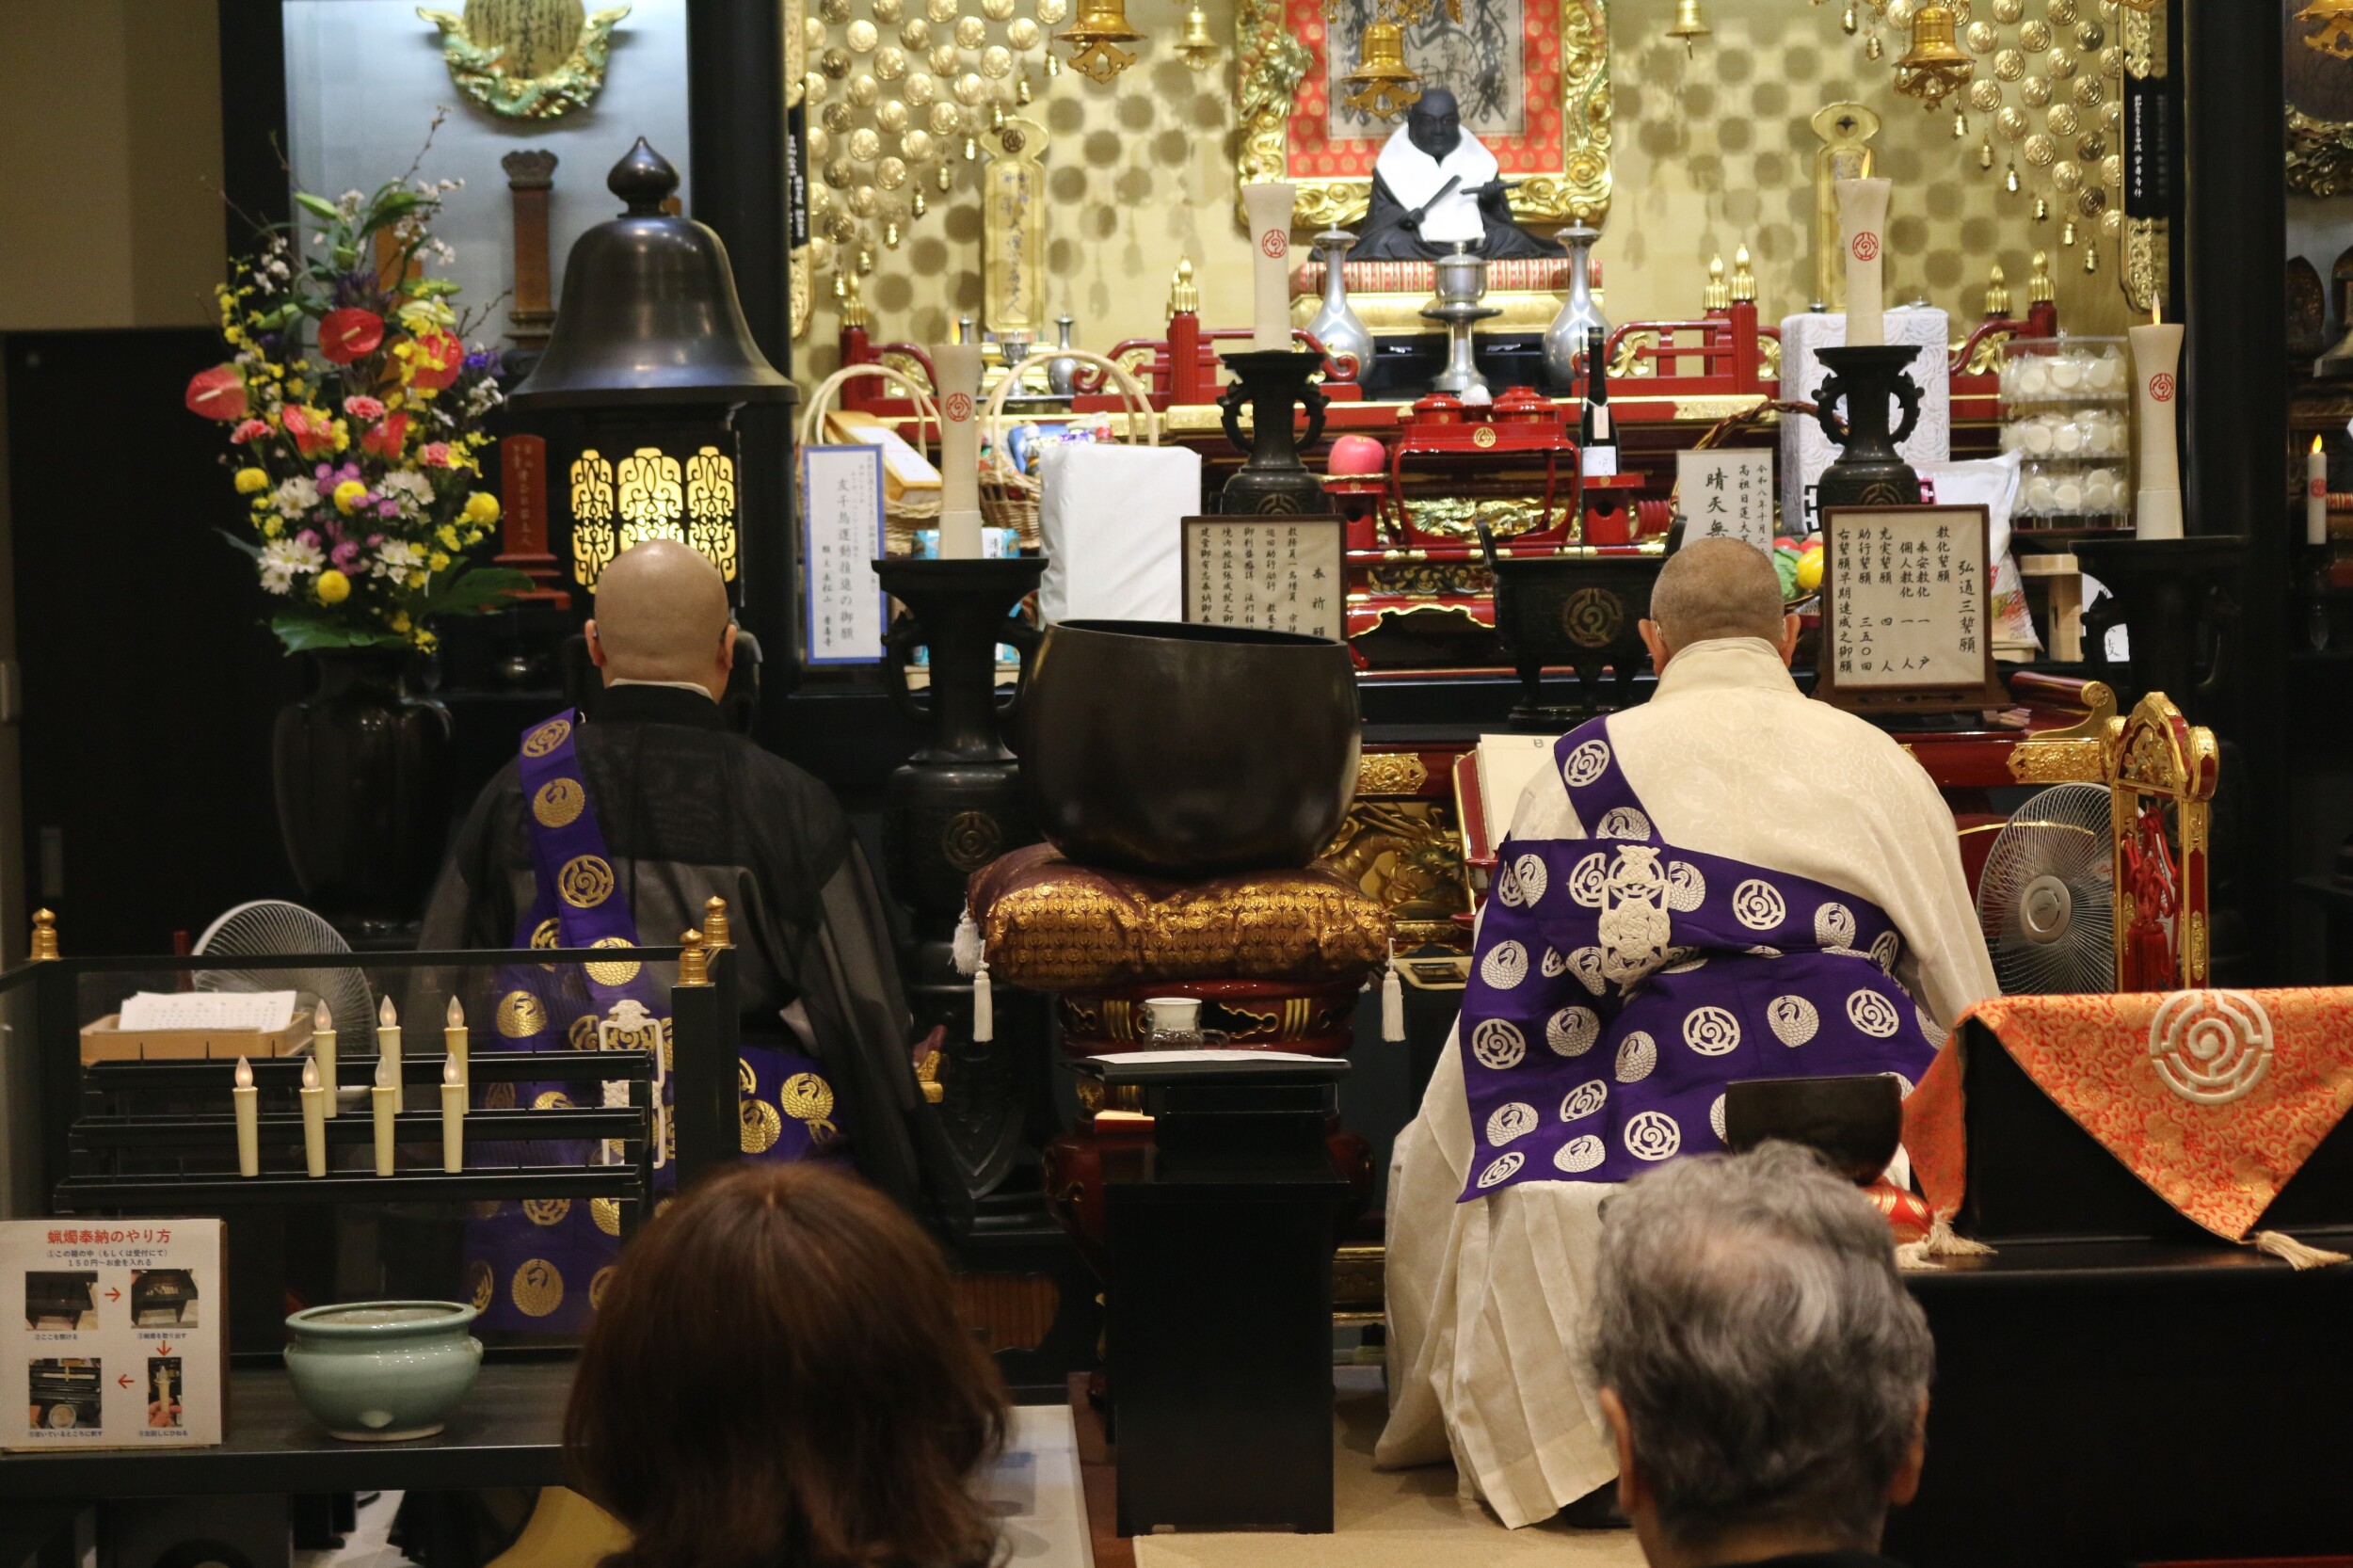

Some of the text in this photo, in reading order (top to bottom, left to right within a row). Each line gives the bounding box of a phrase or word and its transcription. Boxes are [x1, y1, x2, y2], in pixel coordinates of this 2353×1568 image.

[1705, 467, 1729, 537] 晴天無
[1757, 464, 1768, 552] 令和八年十月二
[1858, 528, 1871, 584] 助行誓願
[1880, 527, 1892, 584] 充実誓願
[1900, 541, 1913, 598] 個人教化
[1916, 540, 1930, 598] 奉安教化
[1936, 525, 1950, 583] 教化誓願
[1837, 528, 1852, 673] 右誓願早期達成之御願
[1958, 560, 1976, 653] 弘通三誓願
[47, 1229, 171, 1244] 蝋燭奉納のやり方
